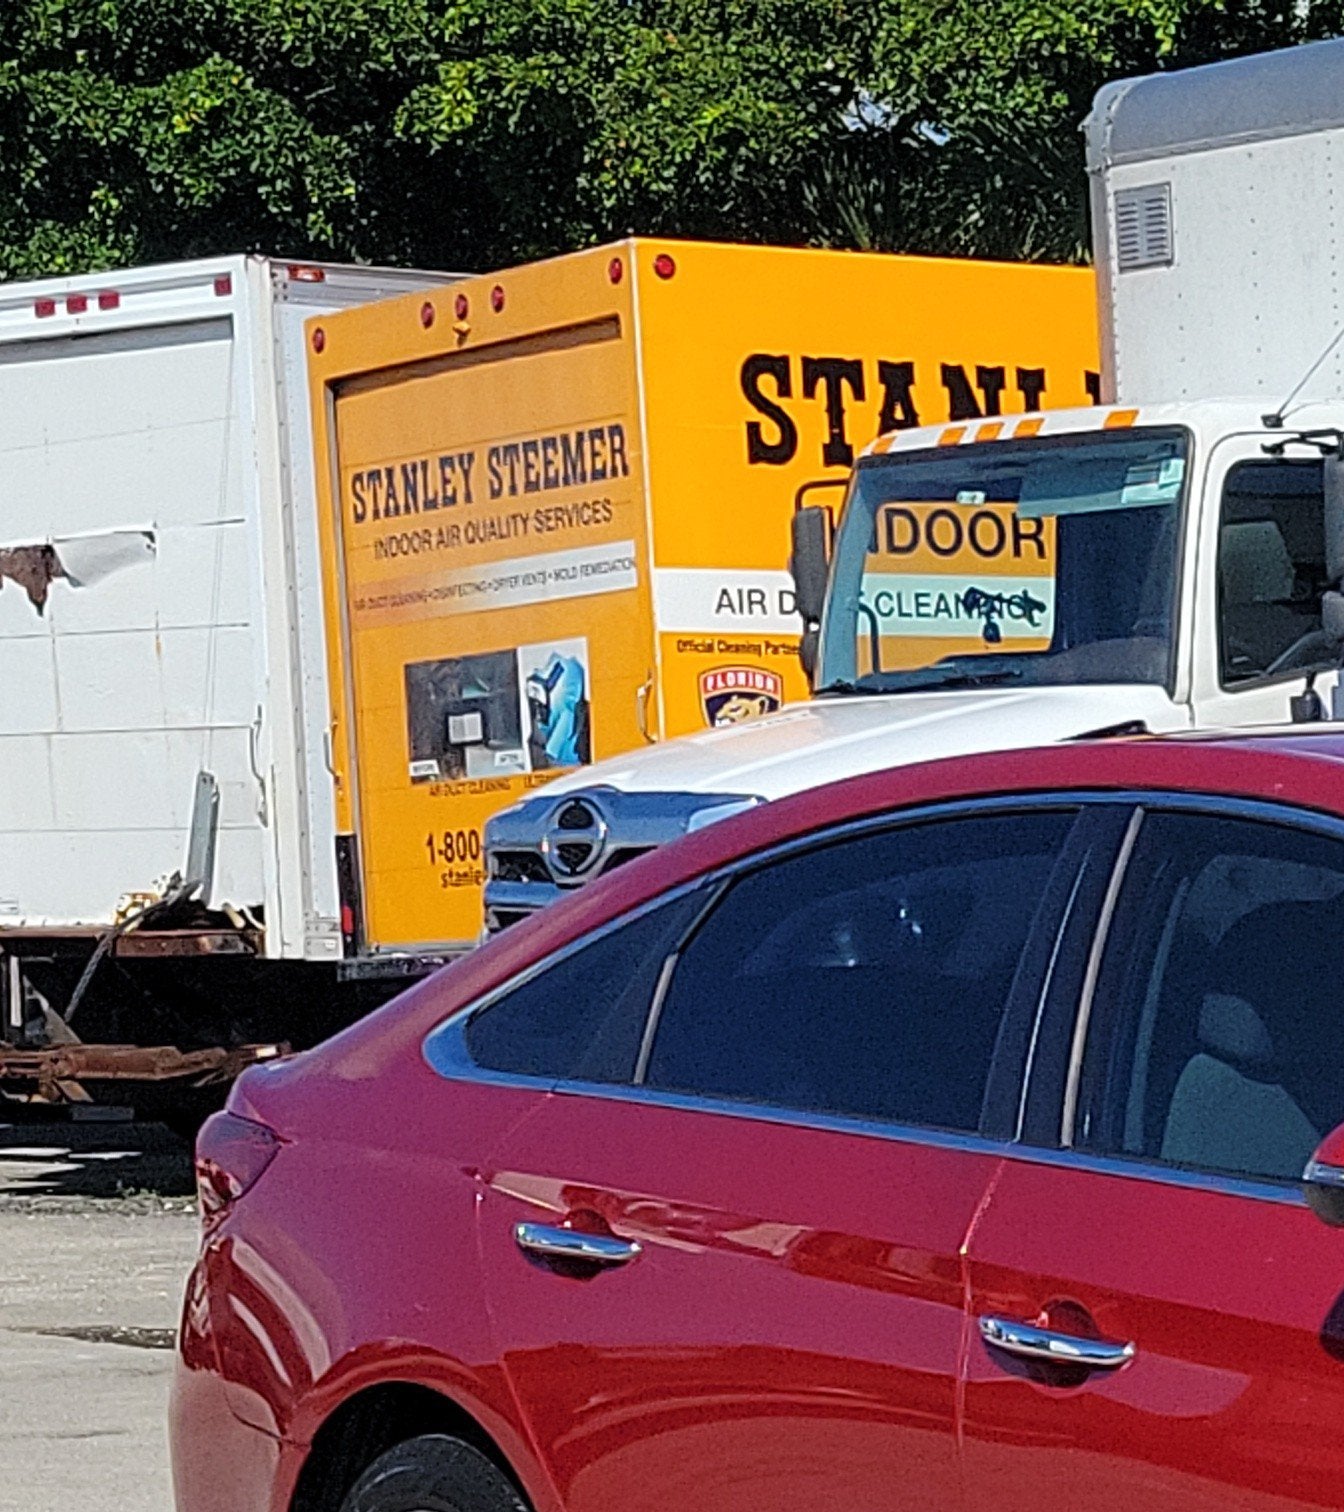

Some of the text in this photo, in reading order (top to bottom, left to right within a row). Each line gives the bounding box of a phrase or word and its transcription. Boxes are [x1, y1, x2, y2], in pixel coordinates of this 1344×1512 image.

[351, 423, 630, 524] STANLEY STEEMER
[374, 497, 614, 560] INDOOR AIR QUALITY SERVICES
[715, 588, 767, 615] AIR
[717, 639, 761, 658] Cleaning
